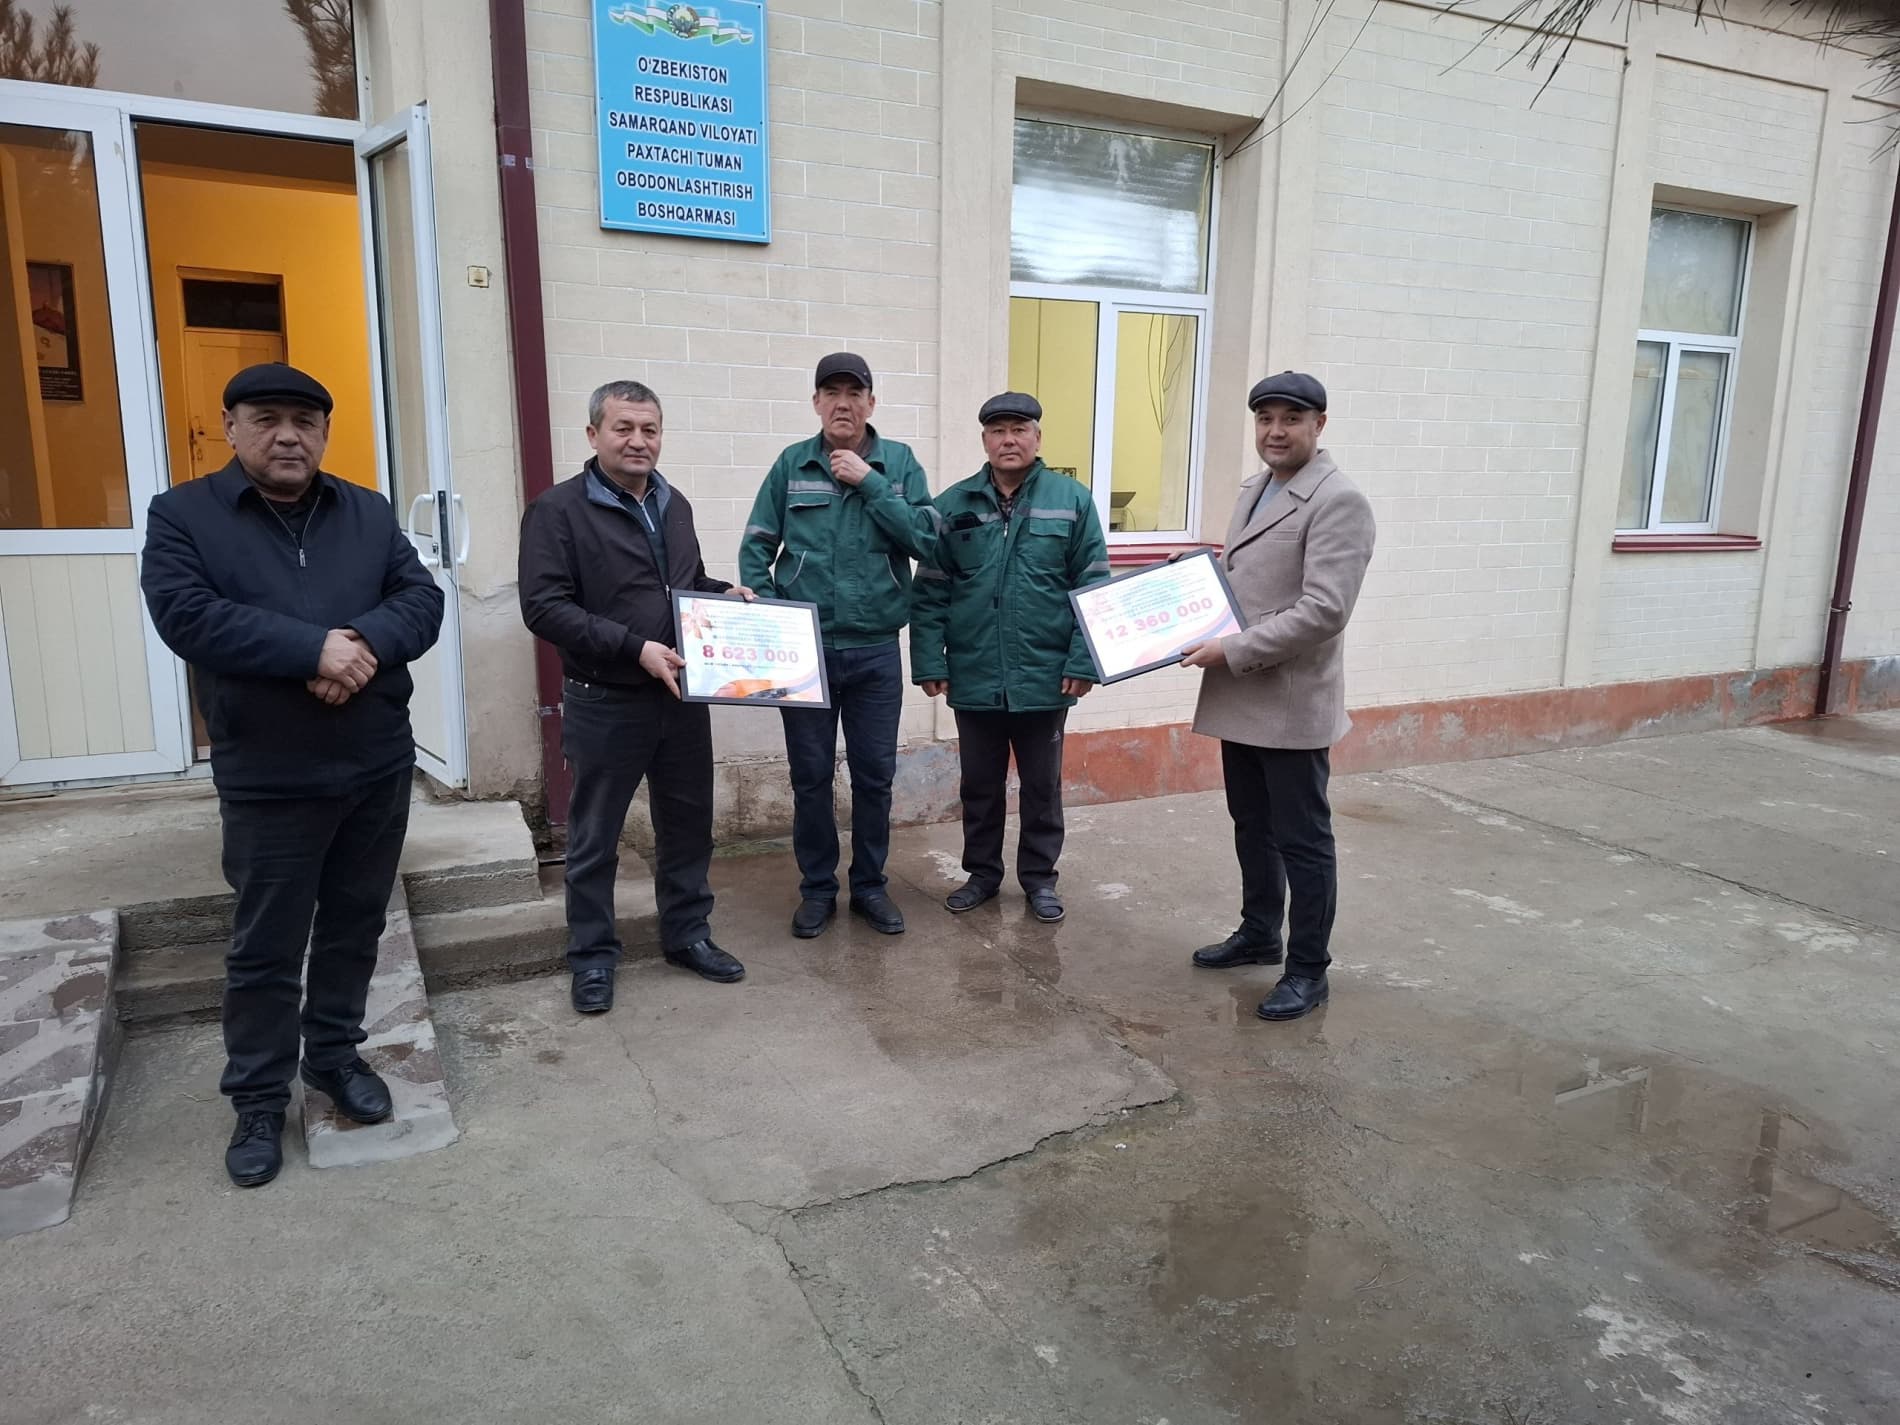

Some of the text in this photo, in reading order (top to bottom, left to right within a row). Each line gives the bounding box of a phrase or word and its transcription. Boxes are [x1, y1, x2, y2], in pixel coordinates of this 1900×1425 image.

[635, 86, 732, 113] RESPUBLIKASI
[609, 112, 757, 145] SAMARQAND VILOYATI
[627, 144, 742, 170] PAXTACHI TUMAN
[617, 171, 753, 199] OBODONLASHTIRISH
[638, 202, 735, 225] BOSHQARMASI
[1105, 625, 1129, 640] 12
[1134, 612, 1170, 631] 360
[1177, 597, 1213, 617] 000
[703, 645, 799, 663] 8 623 000
